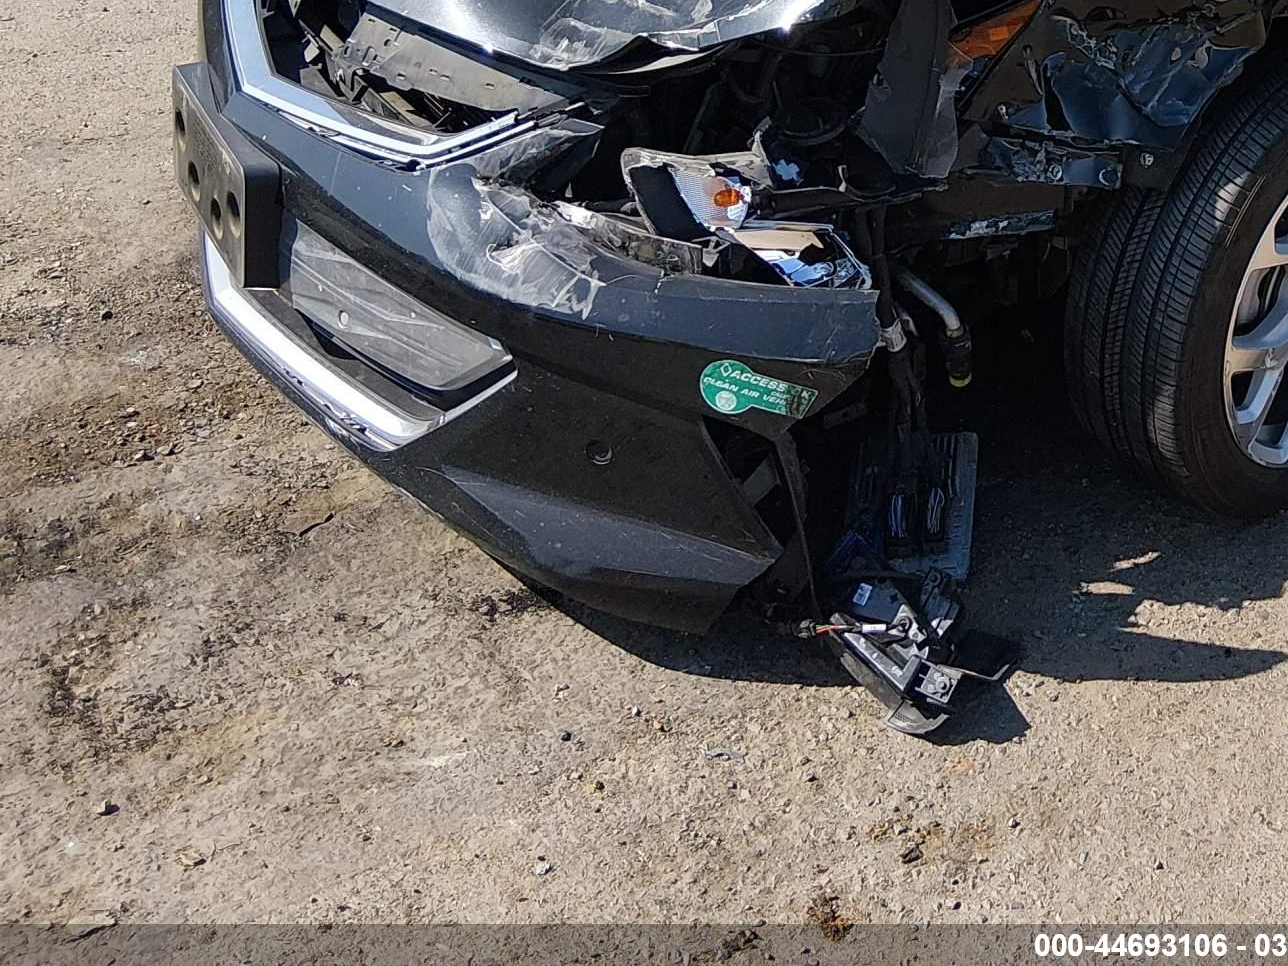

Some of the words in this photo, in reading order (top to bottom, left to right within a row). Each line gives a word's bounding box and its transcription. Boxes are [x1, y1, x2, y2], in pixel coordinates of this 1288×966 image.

[703, 376, 739, 392] CLEAN
[740, 388, 760, 398] AIR
[730, 370, 788, 392] ACCESS
